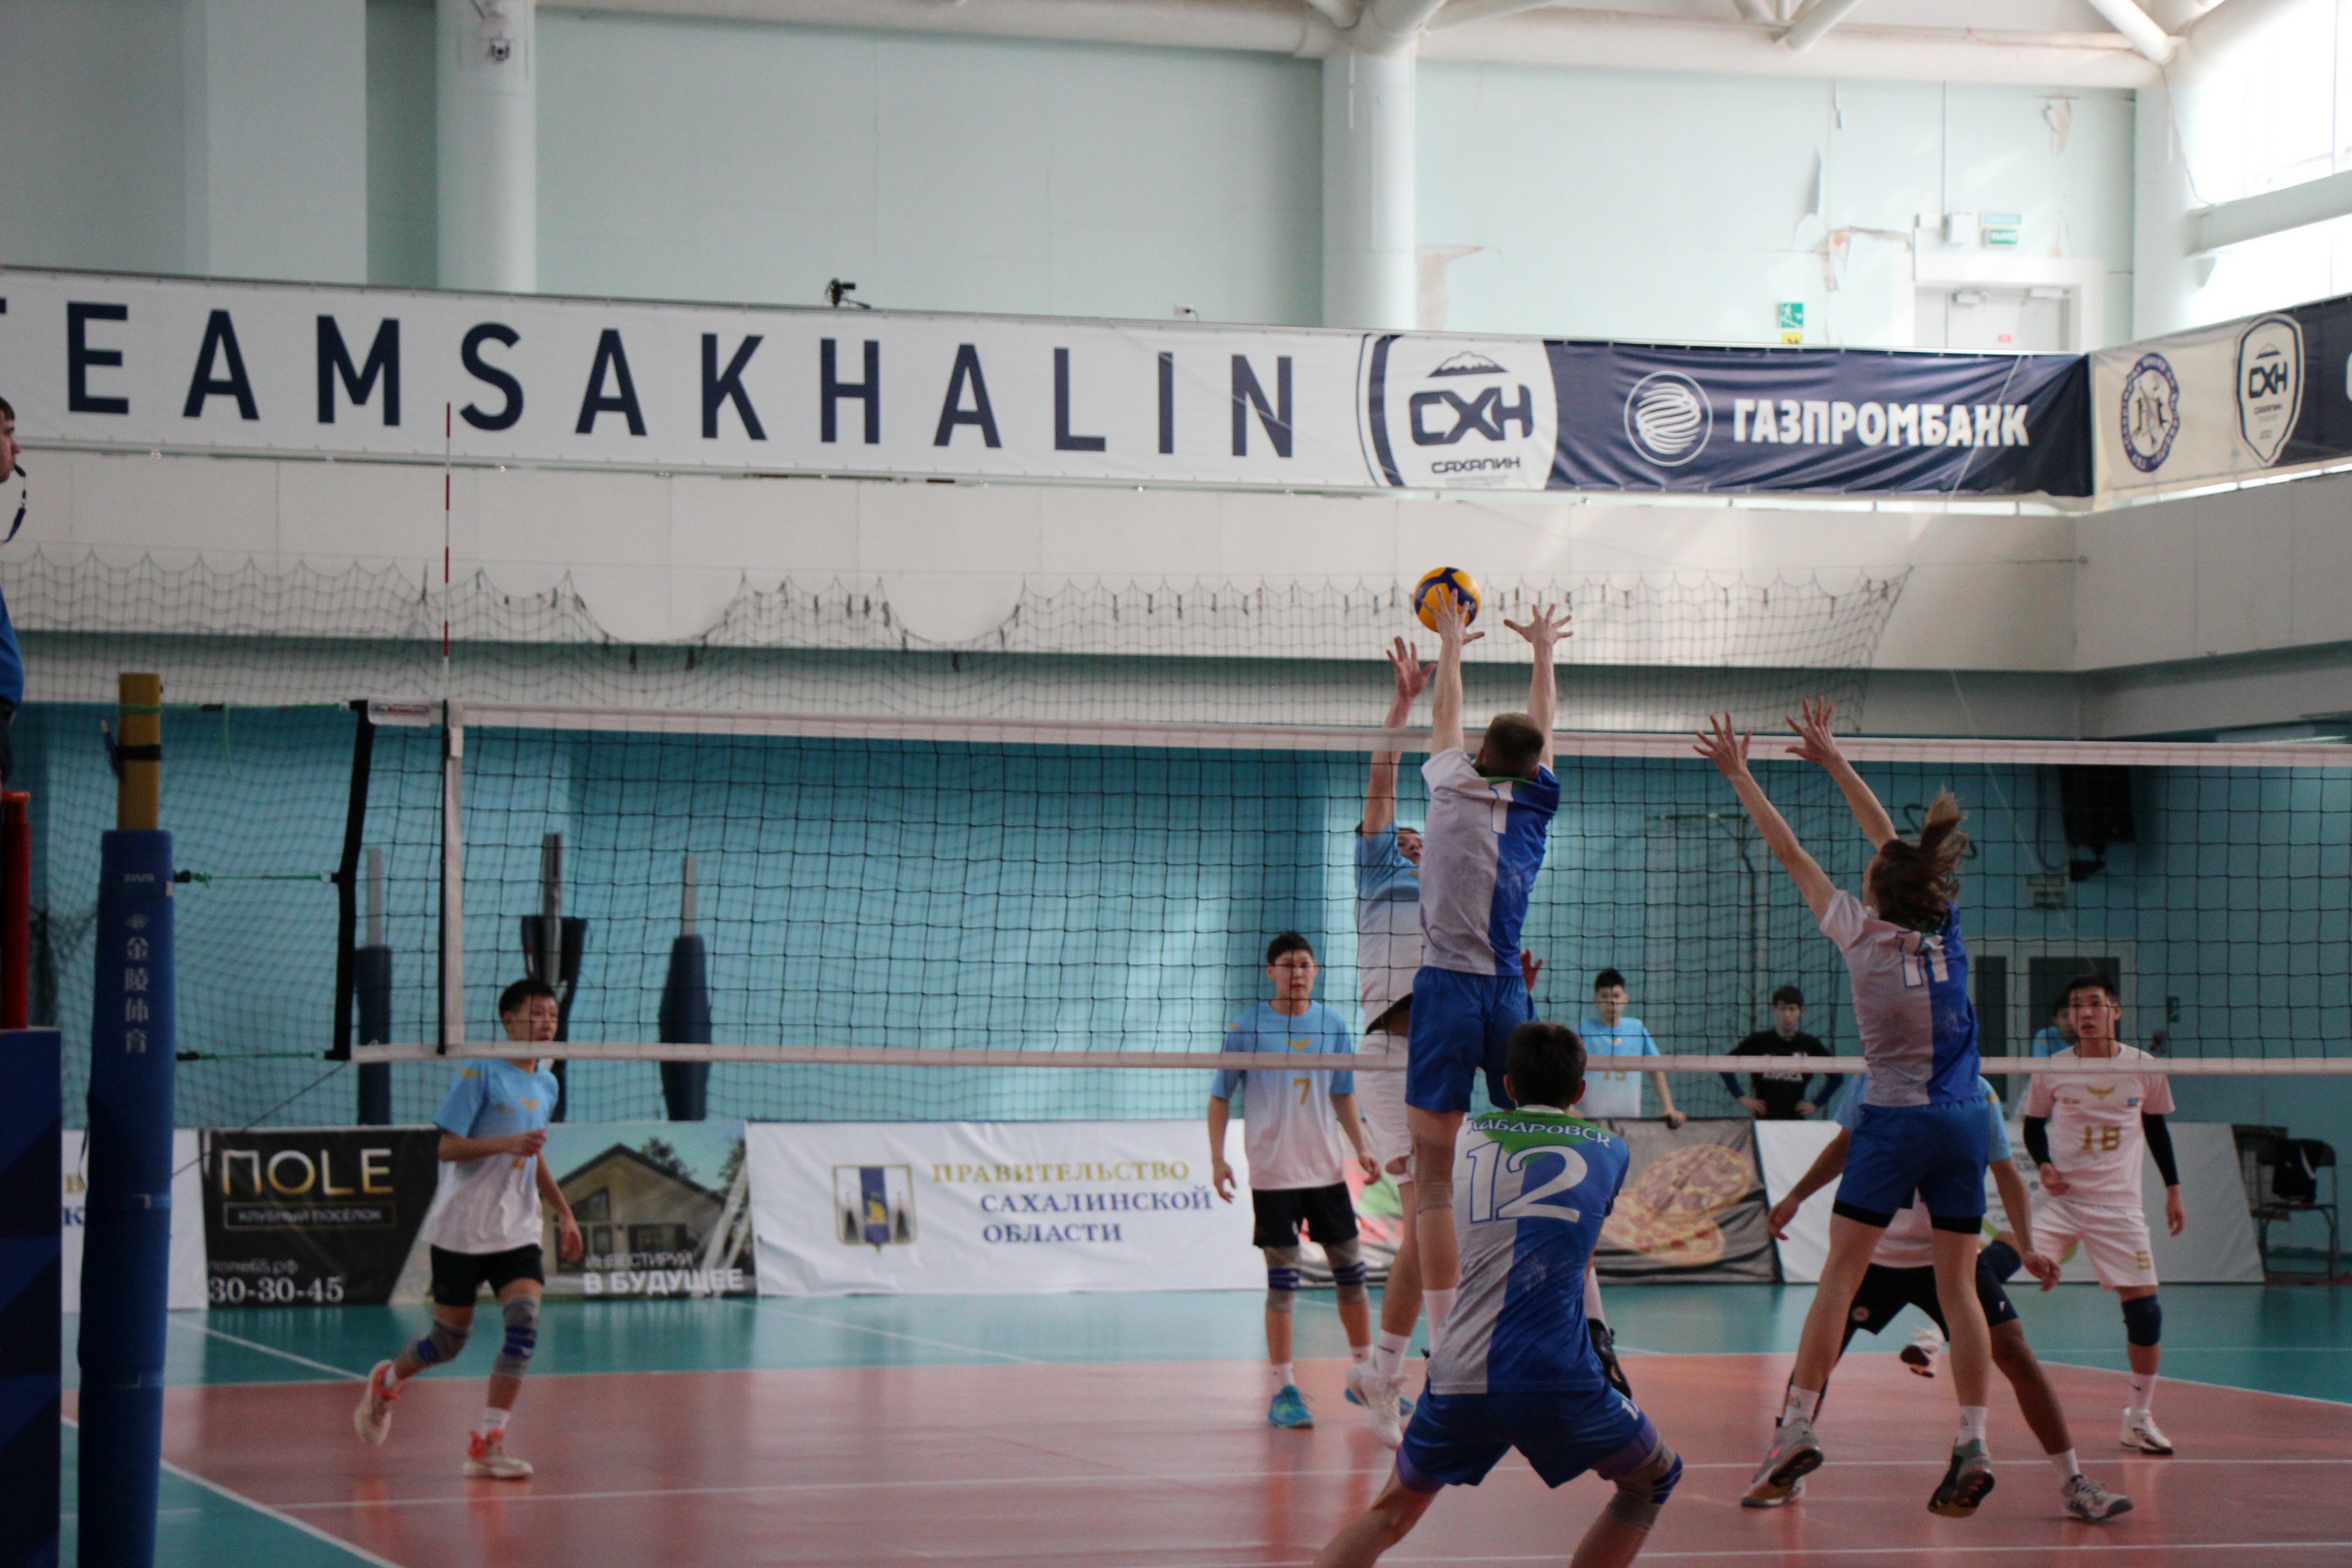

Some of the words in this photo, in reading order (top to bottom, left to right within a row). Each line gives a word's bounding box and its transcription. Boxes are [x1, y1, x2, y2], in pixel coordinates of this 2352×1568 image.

[0, 299, 1294, 459] EAMSAKHALIN
[1734, 398, 2031, 447] ГАЗПРОМБАНК
[1293, 1078, 1311, 1105] 7
[932, 1160, 1190, 1183] ПРАВИТЕЛЬСТВО
[1466, 1139, 1589, 1224] 12
[981, 1186, 1213, 1213] САХАЛИНСКОЙ
[983, 1223, 1123, 1244] ОБЛАСТИ
[583, 1272, 603, 1295] В
[612, 1268, 746, 1296] БУДУЩЕЕ
